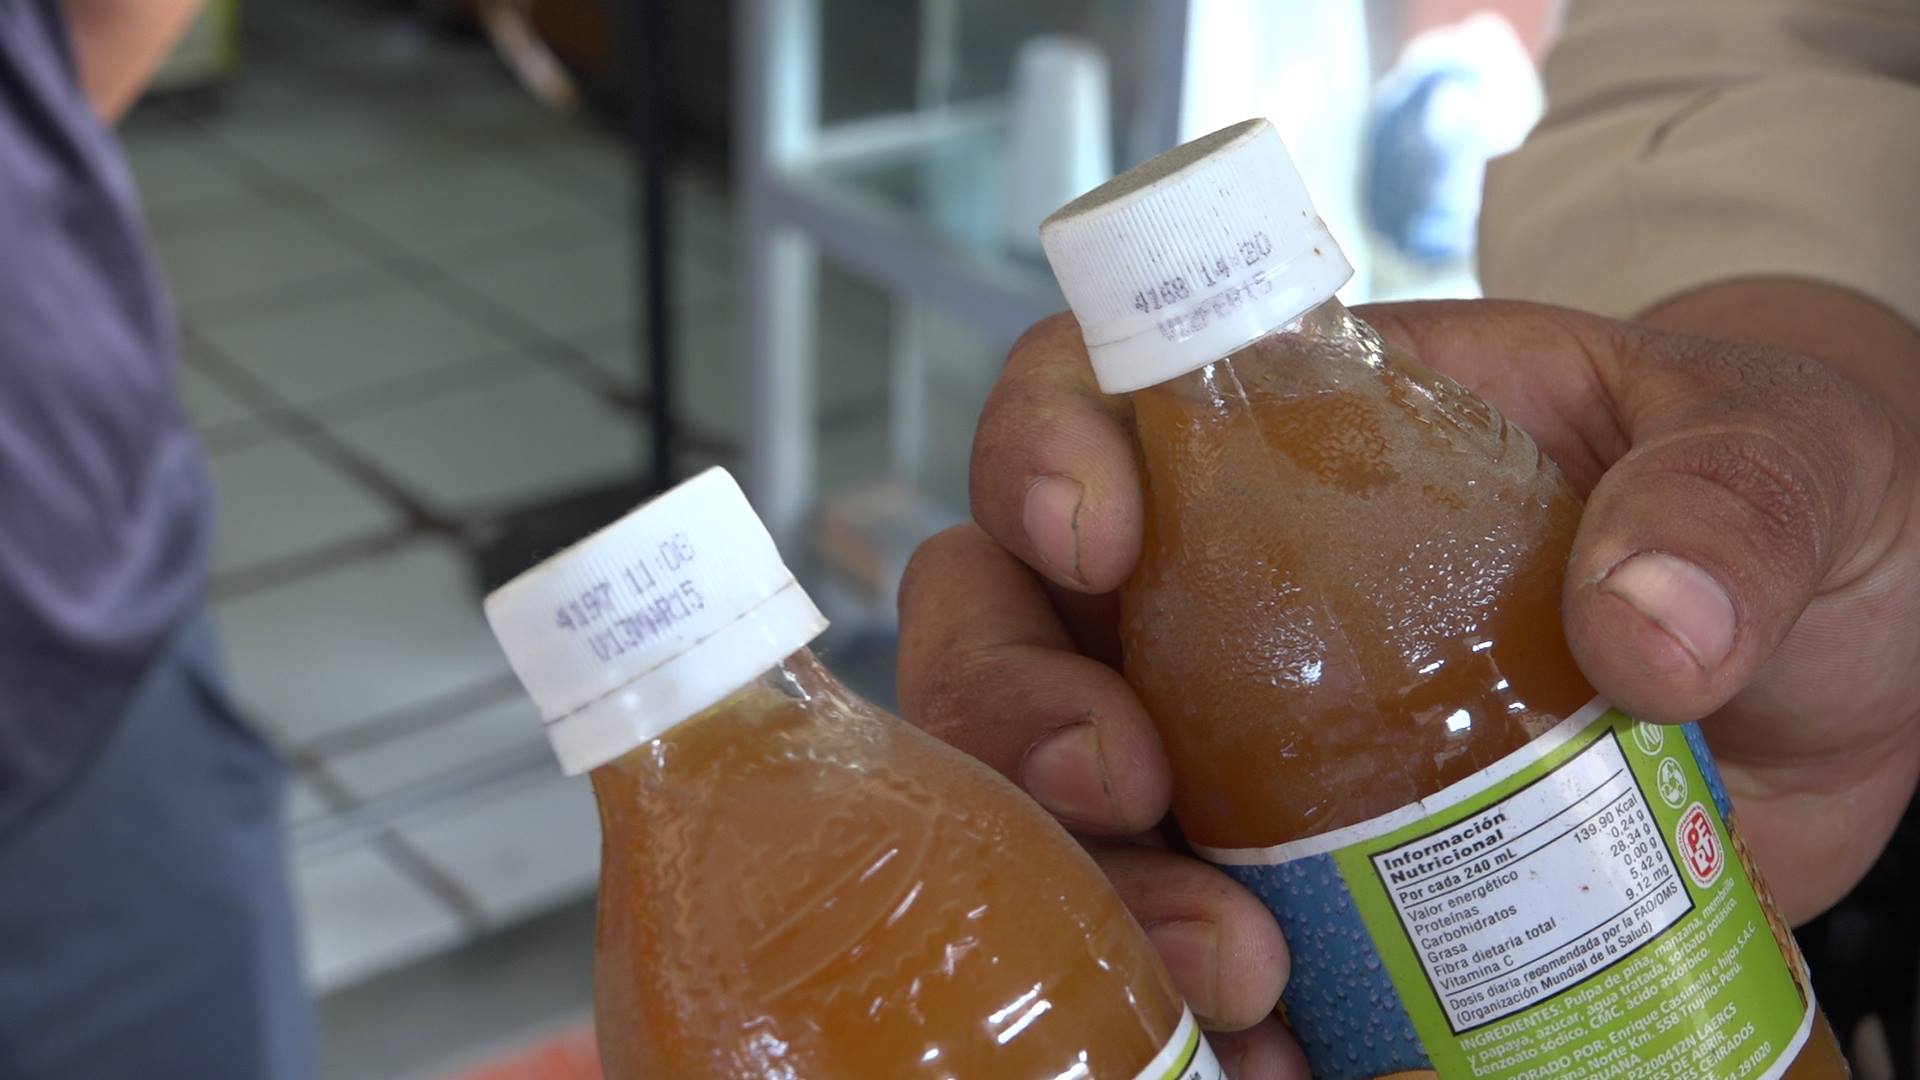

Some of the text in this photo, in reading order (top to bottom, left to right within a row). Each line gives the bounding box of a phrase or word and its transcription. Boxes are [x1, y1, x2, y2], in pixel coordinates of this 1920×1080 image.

[556, 582, 614, 631] 4197
[1384, 812, 1506, 871] Información
[1390, 829, 1504, 884] Nutricional
[1399, 847, 1517, 904] Por cada 240 mL
[1407, 793, 1638, 922] Valor energético 139.90 Kcal
[1414, 905, 1480, 936] Proteínas
[1636, 809, 1645, 821] g
[1420, 904, 1518, 950] Carbohidratos
[1643, 822, 1651, 835] g
[1427, 942, 1468, 964] Grasa
[1649, 836, 1657, 849] g
[1433, 957, 1469, 977] Fibra
[1472, 936, 1523, 964] dietaria
[1525, 916, 1557, 941] total
[1655, 850, 1663, 863] g
[1440, 961, 1501, 991] Vitamina
[1503, 953, 1514, 967] C
[1652, 864, 1670, 881] mg
[1449, 881, 1678, 1011] Dosis diaria recomendada por la FAO/OMS
[1456, 919, 1654, 1025] (Organización Mundial de la Salud)
[1460, 1003, 1564, 1051] INGREDIENTES:
[1564, 984, 1602, 1009] Pulpa
[1604, 972, 1621, 989] de
[1654, 918, 1703, 957] manzana,
[1572, 1039, 1608, 1062] POR:
[1608, 1009, 1660, 1045] Enrique
[1659, 971, 1712, 1014] Cassinelli
[1711, 965, 1719, 976] e
[1718, 944, 1740, 970] hijos
[1586, 992, 1619, 1016] agua
[1668, 930, 1707, 966] sorbato
[1473, 1047, 1538, 1077] benzoato
[1590, 1003, 1625, 1030] CMC,
[1587, 1045, 1628, 1071] Norte
[1655, 1011, 1680, 1034] 558
[1671, 1055, 1691, 1074] DE
